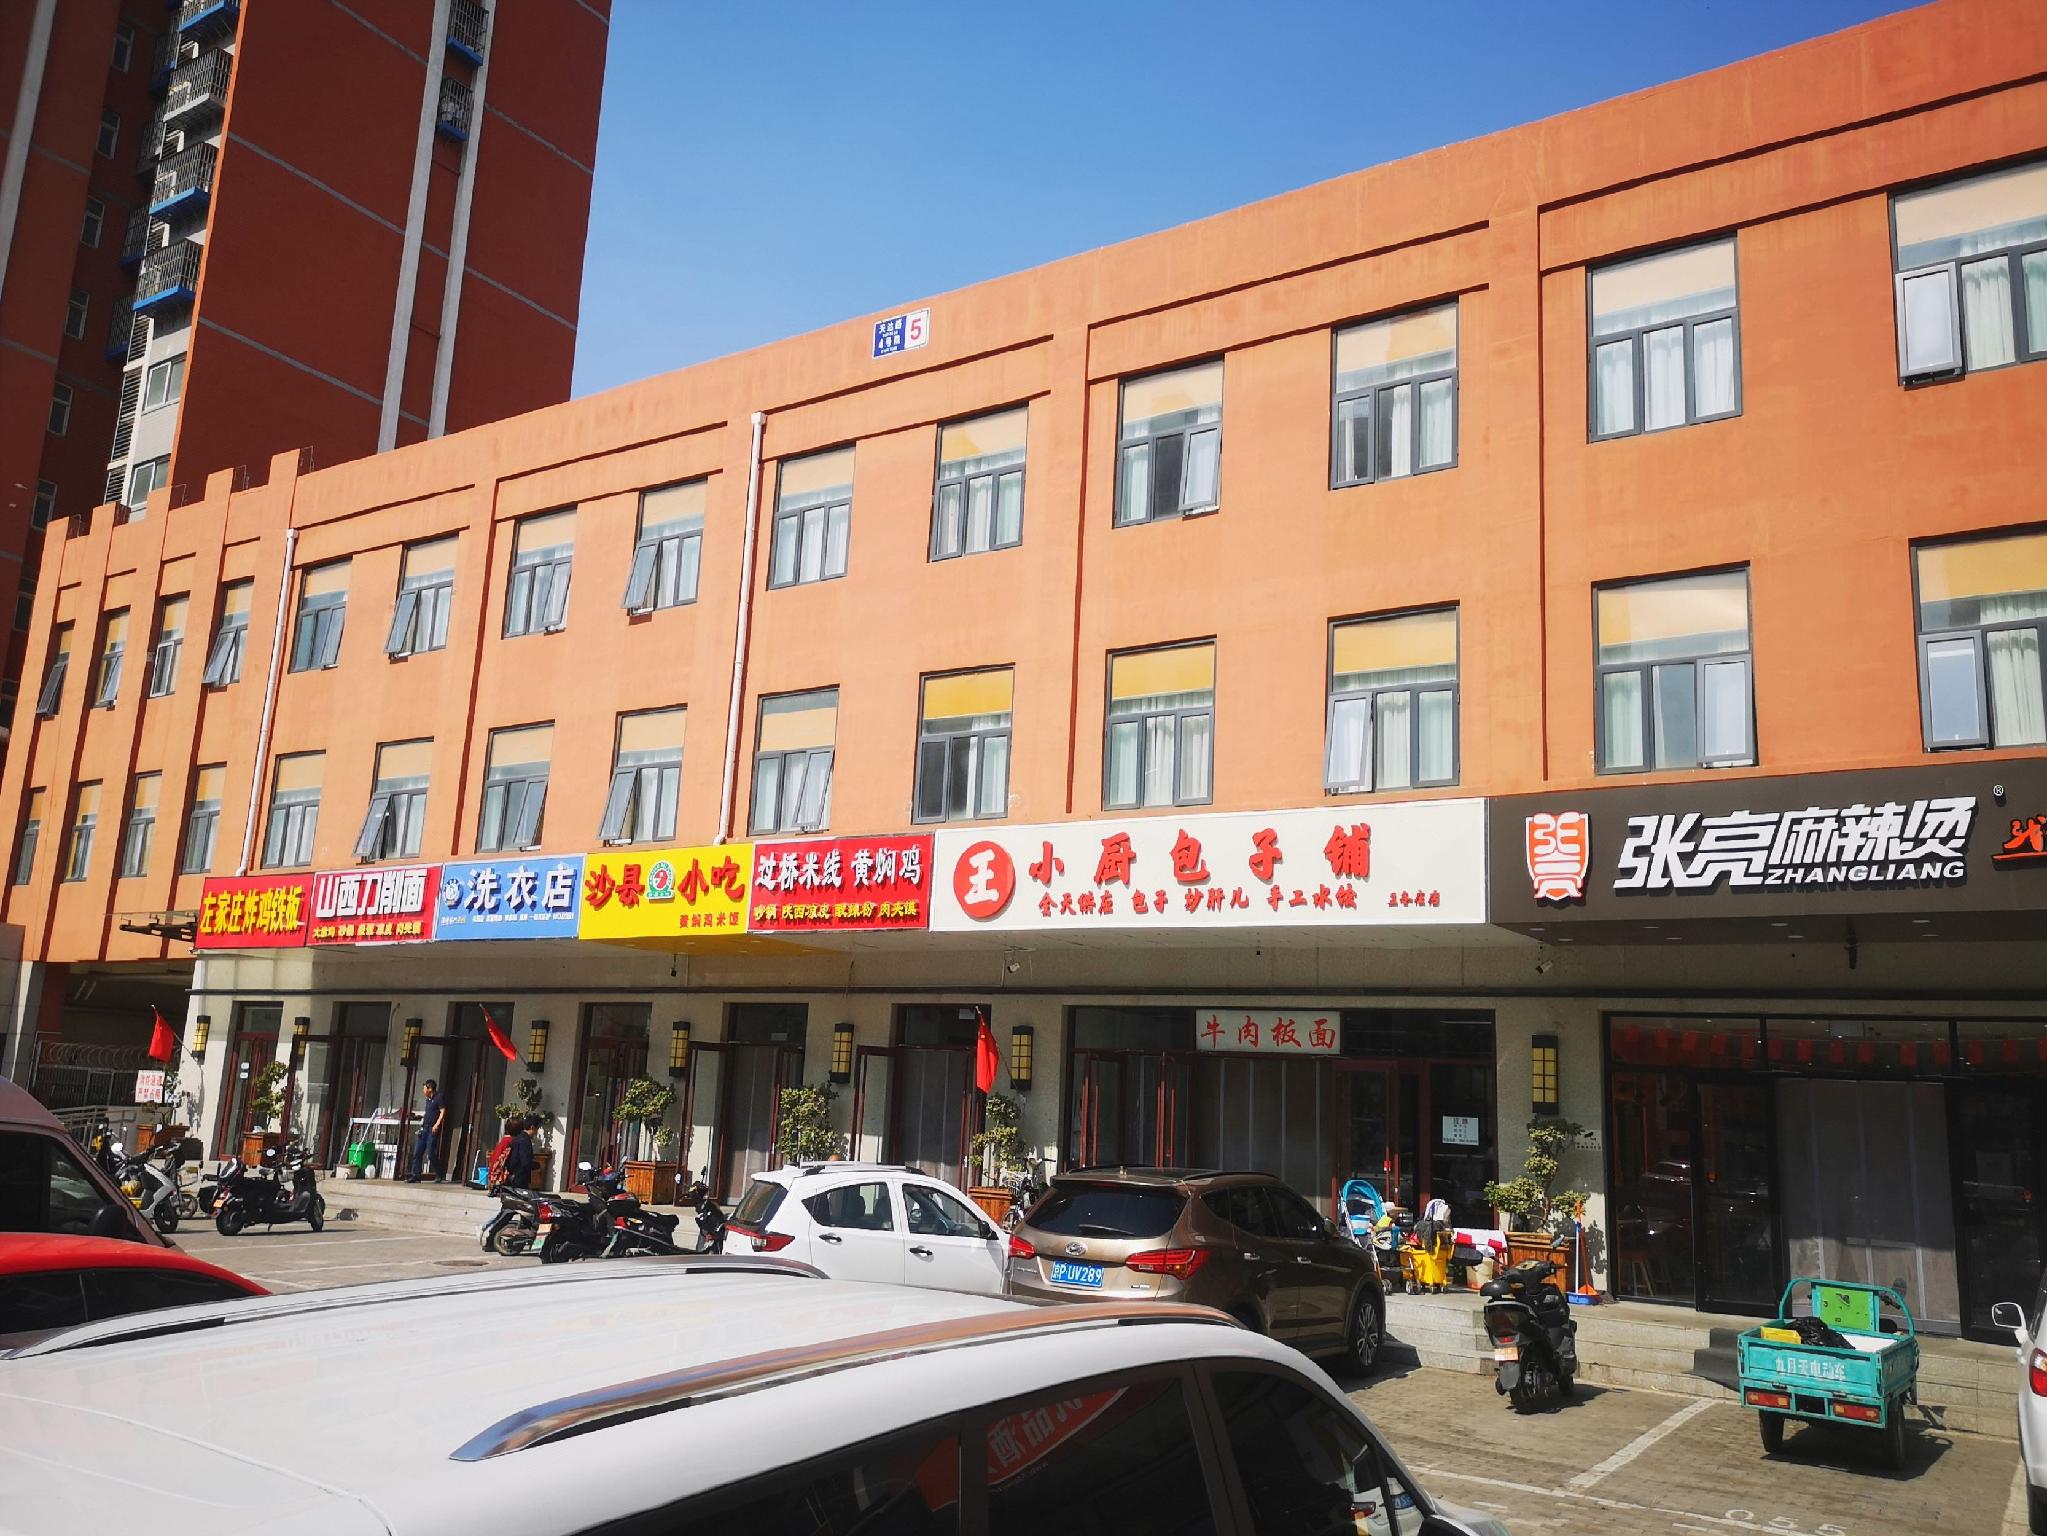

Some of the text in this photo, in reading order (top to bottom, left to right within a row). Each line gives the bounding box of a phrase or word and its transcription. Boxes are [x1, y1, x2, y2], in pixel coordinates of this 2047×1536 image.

[911, 318, 922, 340] 5
[1028, 823, 1372, 888] 小厨包子铺
[1613, 797, 1976, 888] 张亮麻辣烫
[464, 862, 576, 911] 洗衣店
[585, 863, 645, 908] 沙县
[677, 855, 746, 905] 小吃
[754, 844, 922, 892] 过桥米线 黄焖鸡
[1767, 861, 1965, 886] ZHANGLIANG
[315, 868, 428, 918] 山西刀削面
[1131, 888, 1169, 914] 包子
[1184, 887, 1250, 914] 炒肝儿
[1266, 883, 1357, 913] 手工水饺
[1200, 1014, 1337, 1049] 牛肉板面
